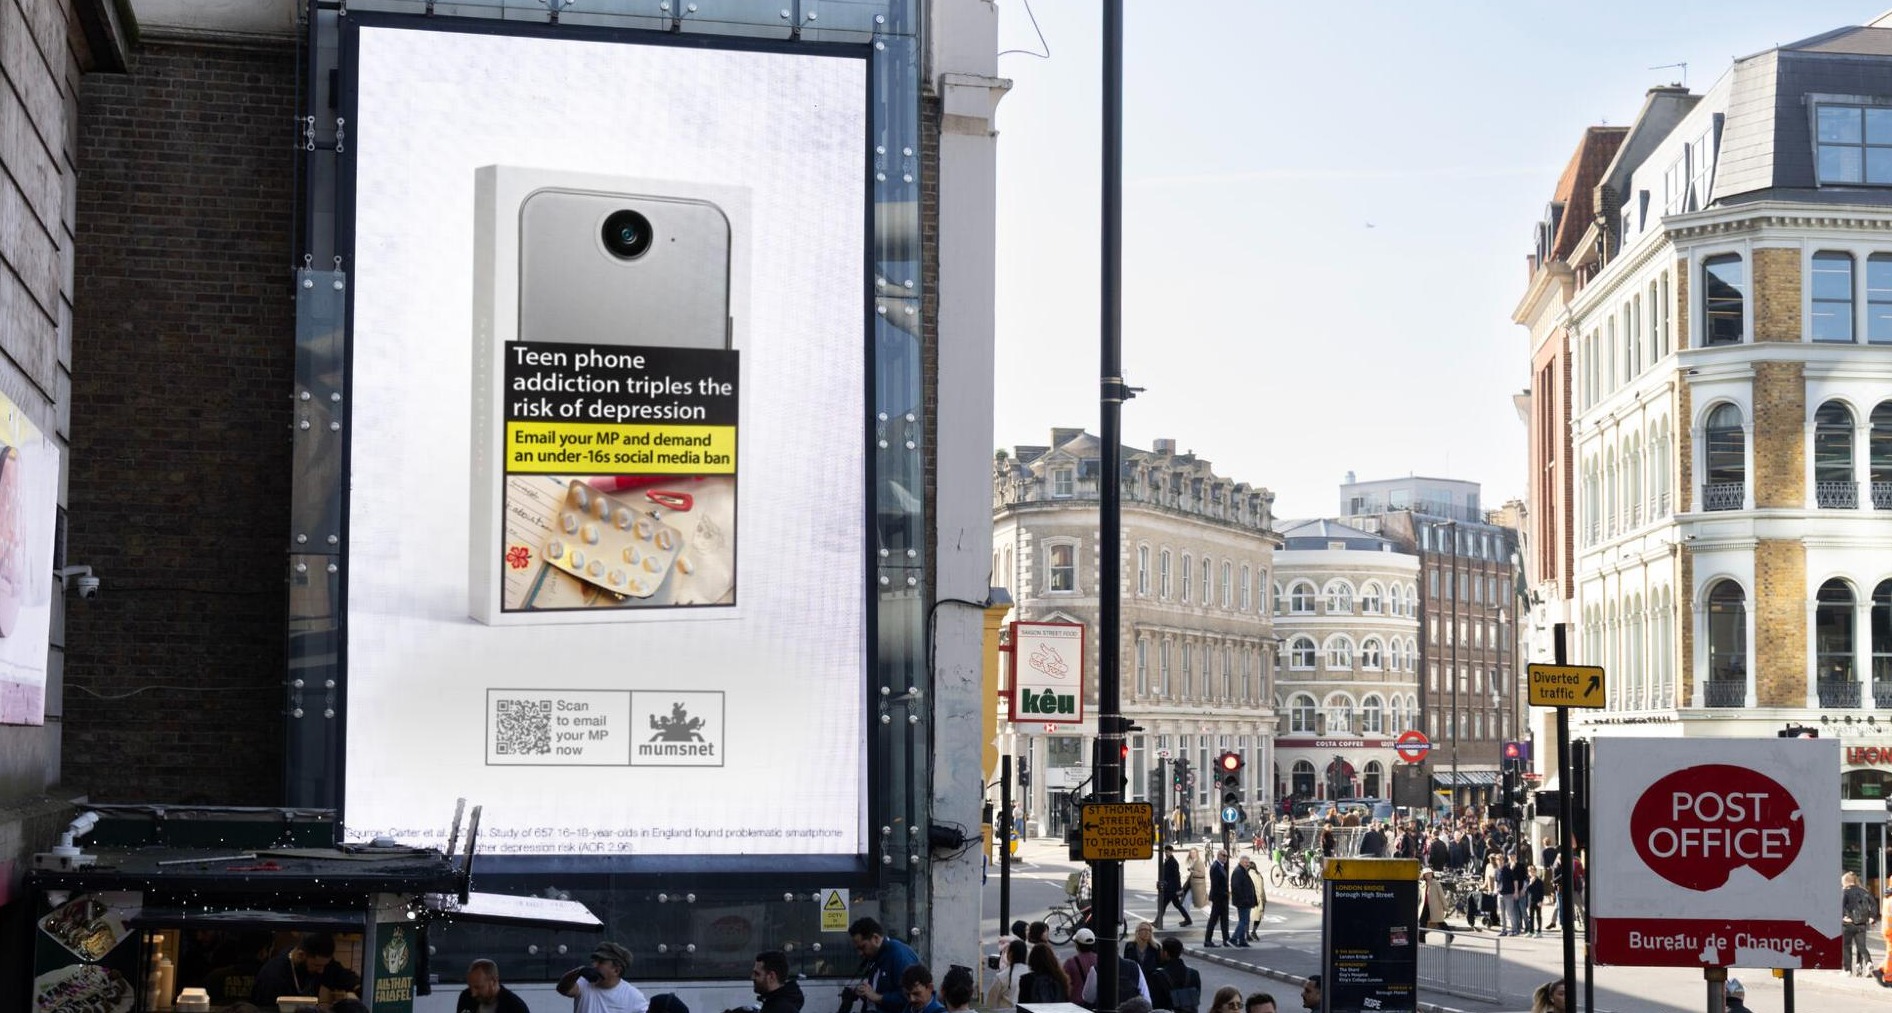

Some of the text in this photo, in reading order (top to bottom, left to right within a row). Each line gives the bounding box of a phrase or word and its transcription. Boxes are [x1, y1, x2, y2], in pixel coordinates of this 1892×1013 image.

[513, 346, 646, 371] Teen phone
[513, 372, 733, 398] addiction triples the
[513, 398, 706, 423] risk of depression
[515, 430, 712, 449] Email your MP and demand
[514, 449, 730, 465] an under-16s social media ban
[1534, 671, 1579, 684] Diverted
[1540, 687, 1575, 699] traffic
[556, 700, 589, 712] Scan
[1021, 688, 1075, 714] kêu
[556, 716, 607, 726] to email
[556, 730, 609, 742] your MP
[556, 746, 583, 756] now
[639, 743, 715, 757] mumsnet
[1847, 747, 1892, 765] LEON
[1089, 805, 1147, 815] ST THOMAS
[1672, 792, 1768, 821] POST
[1098, 816, 1137, 825] STREET
[389, 828, 419, 837] Carter
[423, 829, 434, 837] et
[437, 829, 448, 837] al.
[490, 828, 519, 839] Study
[522, 828, 532, 837] of
[535, 828, 553, 837] 657
[641, 828, 650, 837] in
[652, 828, 691, 839] England
[695, 828, 723, 837] found
[725, 828, 782, 839] problematic
[785, 829, 843, 839] smartphone
[1098, 827, 1138, 836] CLOSED
[500, 843, 555, 853] depression
[558, 843, 575, 852] risk
[1085, 837, 1150, 847] TO THROUGH
[1648, 827, 1783, 859] OFFICE
[1098, 848, 1138, 857] TRAFFIC
[1629, 931, 1805, 953] Bureau de Change
[375, 989, 412, 1003] FALAFEL
